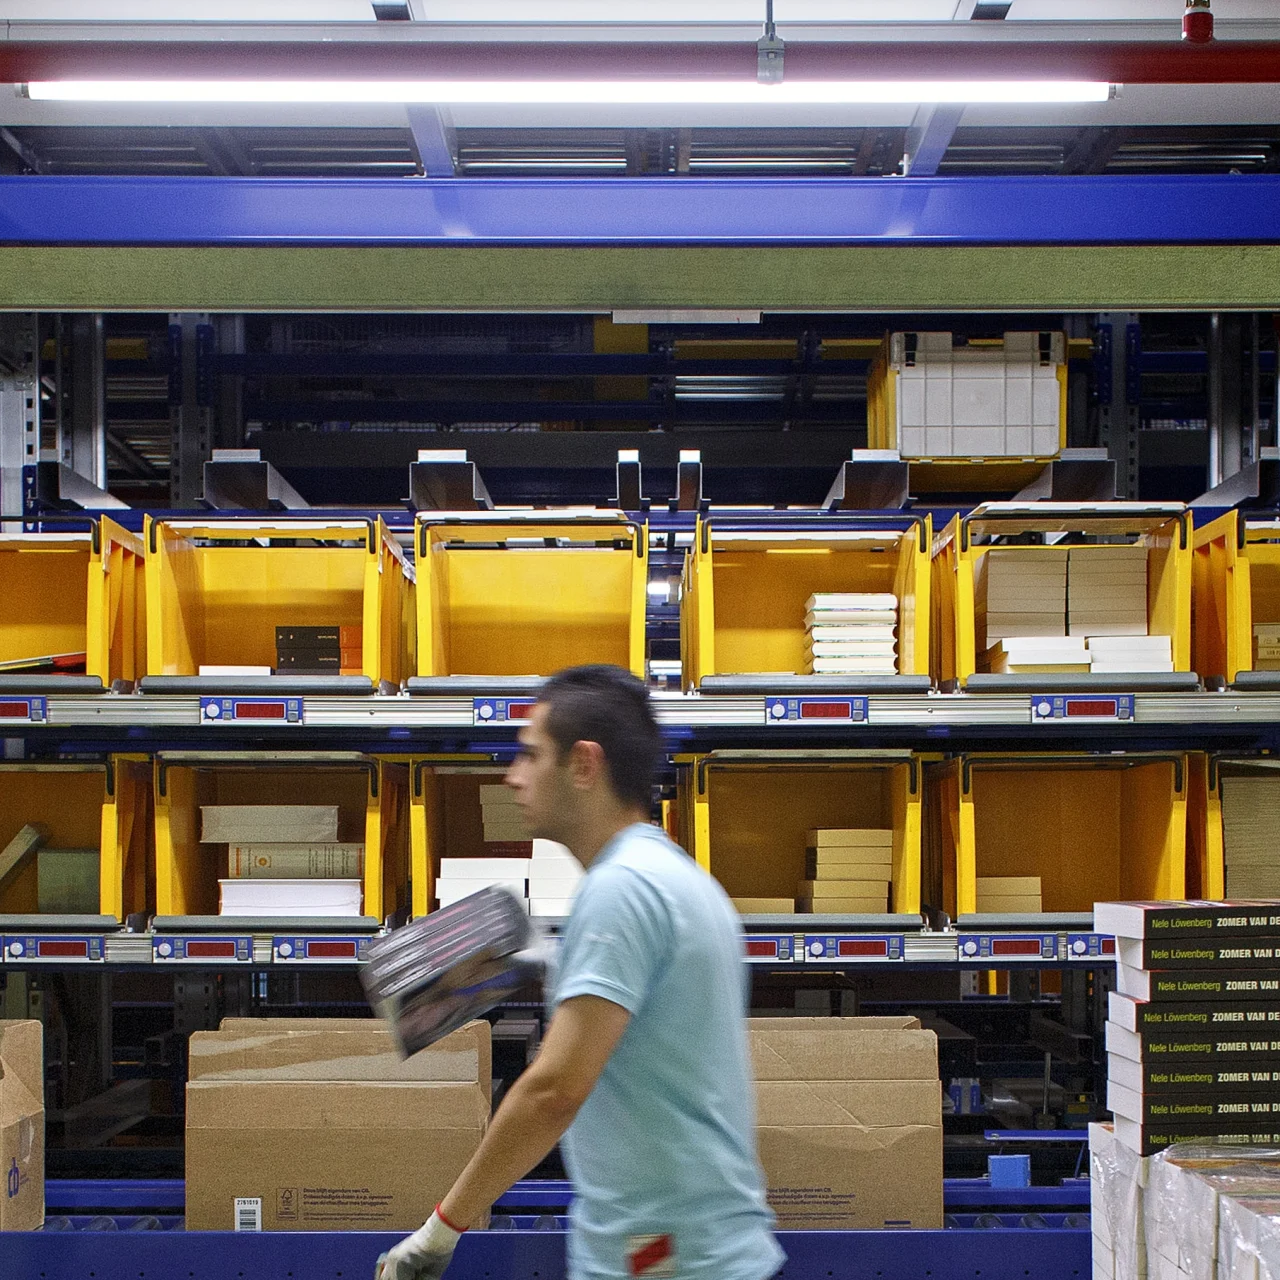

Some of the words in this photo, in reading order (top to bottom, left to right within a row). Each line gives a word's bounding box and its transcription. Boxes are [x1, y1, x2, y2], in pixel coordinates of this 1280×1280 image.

[1152, 920, 1169, 928] Nele
[1217, 918, 1247, 926] ZOMER
[1249, 917, 1266, 925] VAN
[1269, 917, 1280, 925] DE
[1171, 950, 1214, 958] Löwenberg
[1220, 950, 1251, 958] ZOMER
[1254, 949, 1272, 957] VAN
[1226, 981, 1258, 990] ZOMER
[1260, 981, 1279, 989] VAN
[1144, 1014, 1162, 1022] Nele
[1164, 1013, 1208, 1021] Löwenberg
[1213, 1013, 1244, 1021] ZOMER
[1268, 1012, 1280, 1020] DE
[1149, 1044, 1167, 1052] Nele
[1169, 1044, 1211, 1052] Löwenberg
[1216, 1043, 1247, 1051] ZOMER
[1250, 1042, 1268, 1050] VAN
[1170, 1074, 1213, 1082] Löwenberg
[1218, 1073, 1249, 1081] ZOMER
[1252, 1073, 1270, 1081] VAN
[1151, 1106, 1168, 1114] Nele
[1218, 1104, 1249, 1113] ZOMER
[1252, 1104, 1269, 1112] VAN
